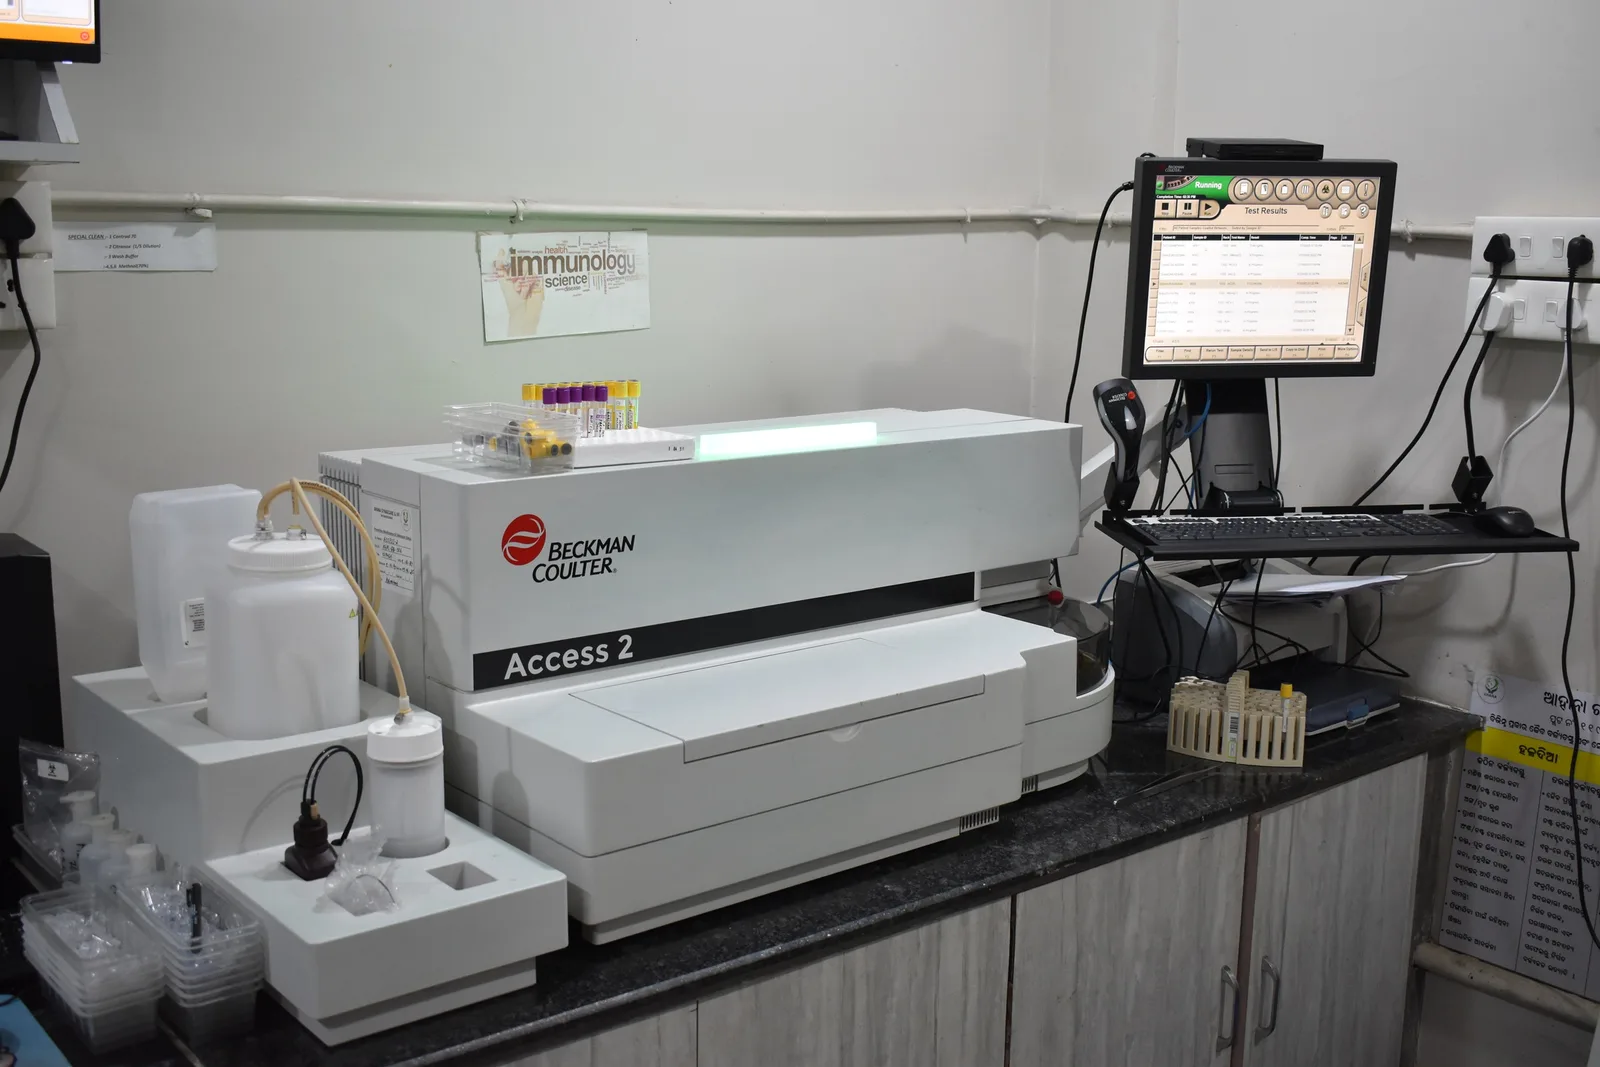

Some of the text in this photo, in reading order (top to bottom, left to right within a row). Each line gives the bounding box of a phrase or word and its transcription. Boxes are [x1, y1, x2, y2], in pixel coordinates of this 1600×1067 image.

[1195, 182, 1222, 190] Running
[508, 247, 636, 276] immunology
[544, 246, 568, 254] health
[545, 274, 588, 288] science
[548, 534, 636, 561] BECKMAN
[532, 557, 613, 583] COULTER
[504, 634, 633, 680] Access 2
[1519, 744, 1558, 764] ହଳଦିଆ
